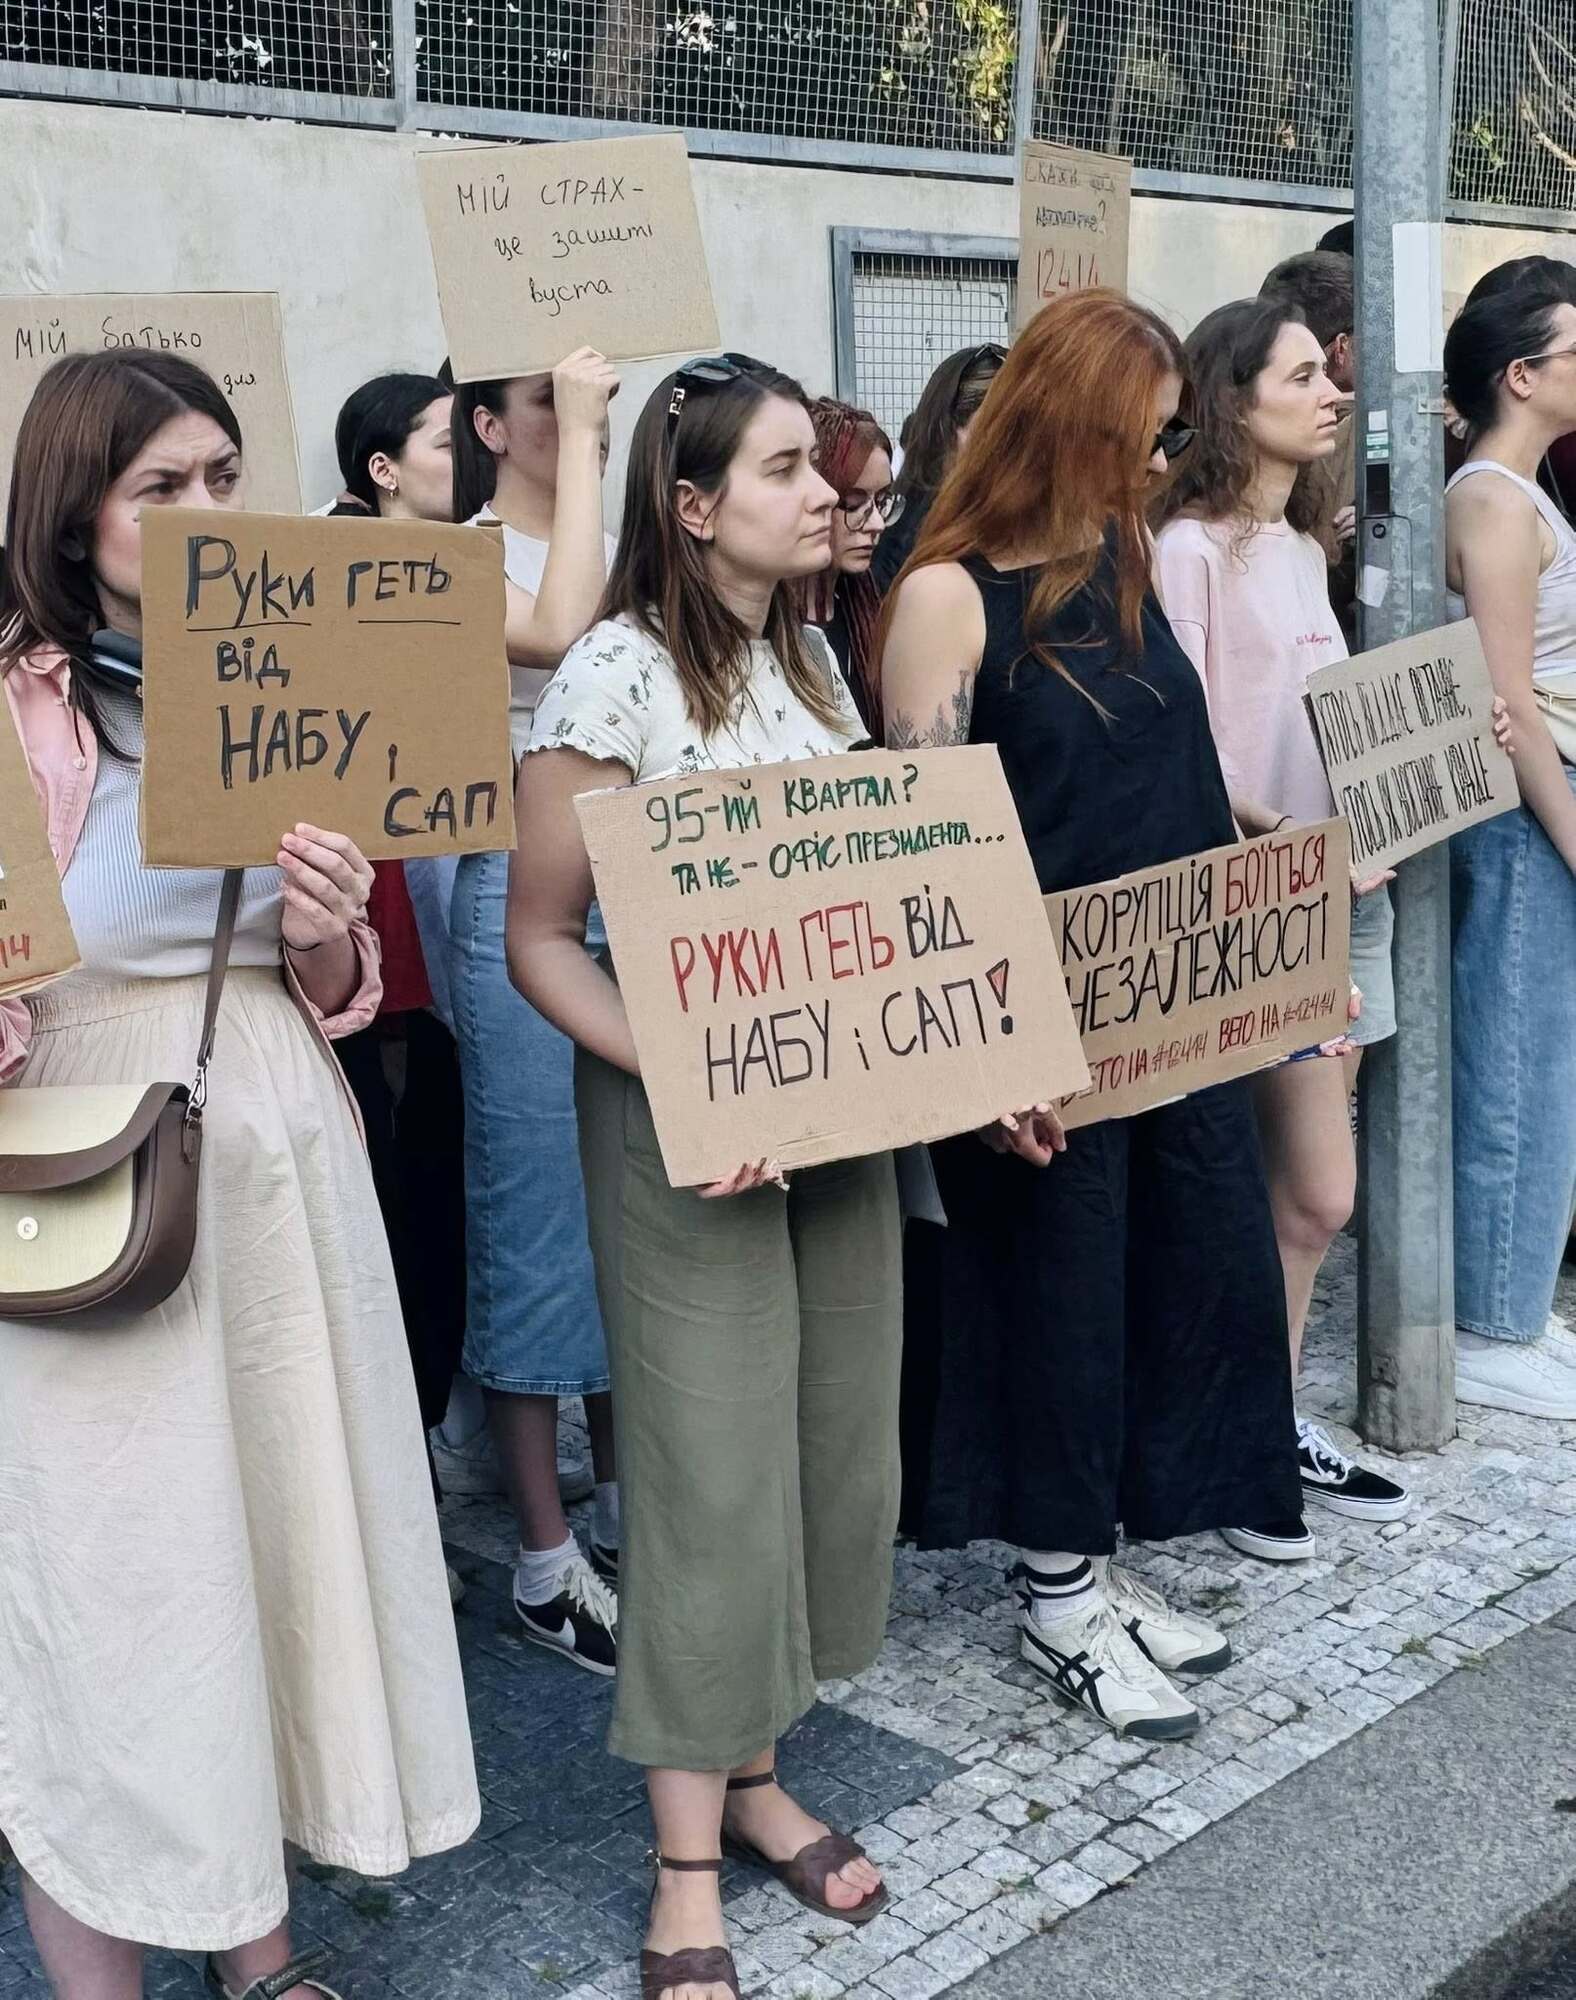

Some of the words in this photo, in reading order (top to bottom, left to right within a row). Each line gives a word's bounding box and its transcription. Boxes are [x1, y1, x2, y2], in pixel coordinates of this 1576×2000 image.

[457, 174, 510, 215] МІЙ
[1036, 249, 1099, 300] 12414
[216, 704, 372, 791] НАБУ
[1316, 689, 1364, 768] ХТОСЬ
[383, 781, 498, 838] САП
[783, 763, 919, 818] КВАРТАЛ?
[1061, 859, 1213, 966] КОРУПЦІЯ
[1224, 832, 1326, 917] БОЇТЬСЯ
[669, 926, 786, 1014] РУКИ
[799, 901, 896, 982] ГЕТЬ
[1065, 891, 1330, 1036] НЕЗАЛЕЖНОСТІ
[705, 999, 831, 1102] НАБУ
[880, 958, 1015, 1056] САП!
